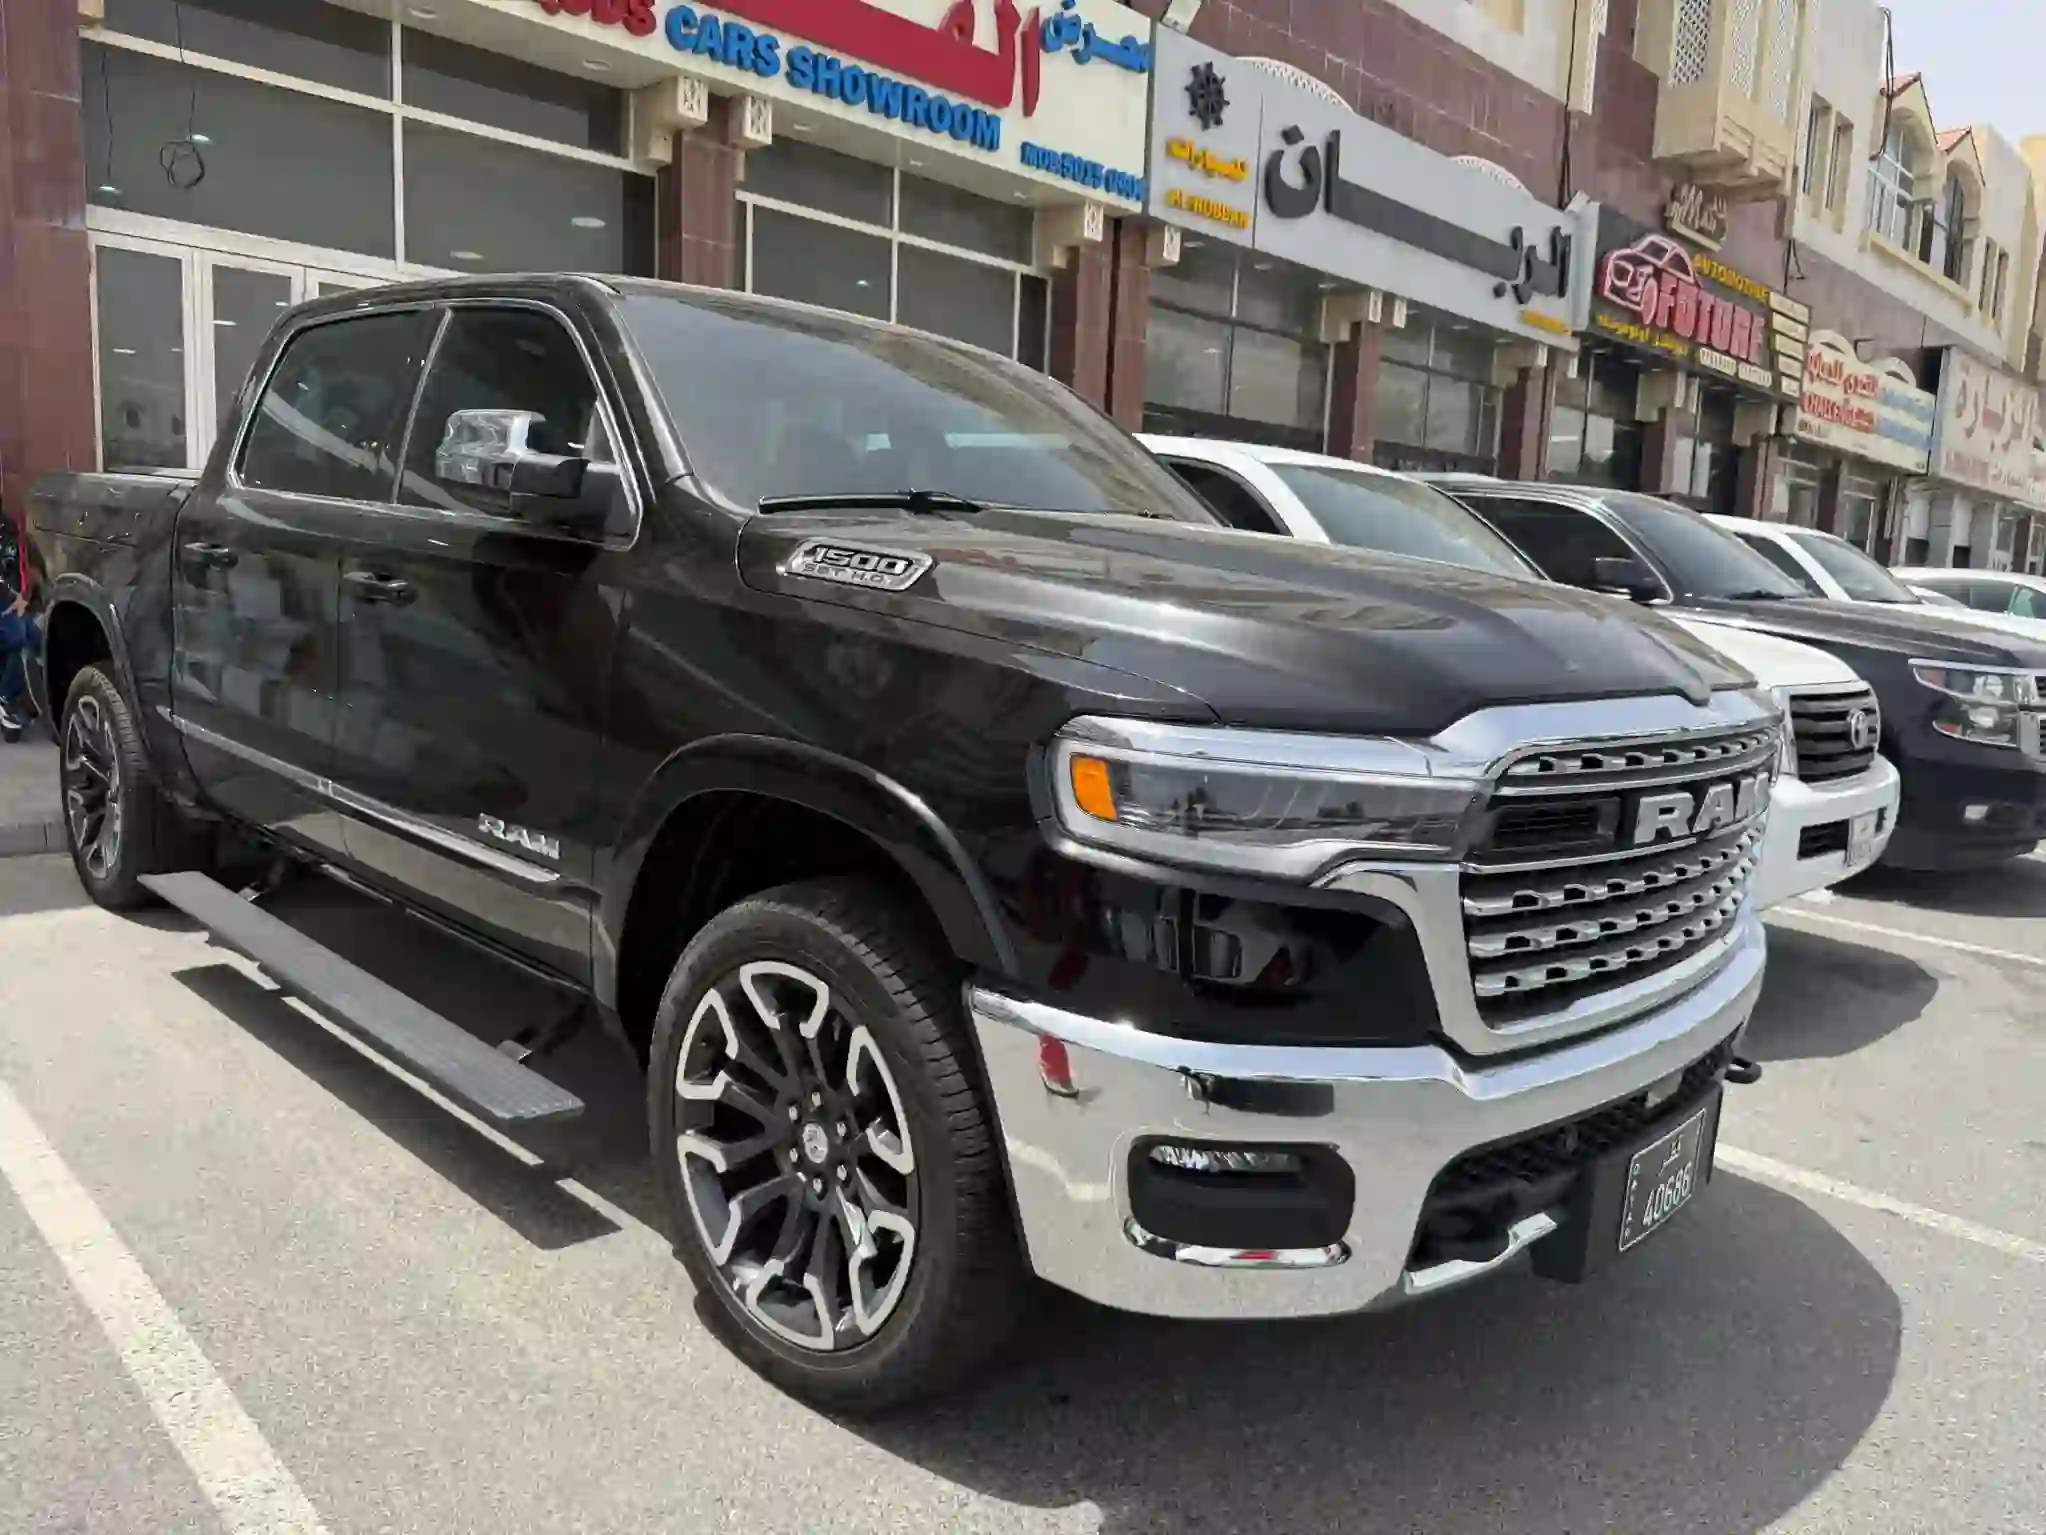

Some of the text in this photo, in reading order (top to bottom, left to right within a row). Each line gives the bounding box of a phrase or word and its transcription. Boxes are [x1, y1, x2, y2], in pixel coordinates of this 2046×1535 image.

[665, 5, 780, 77] CARS
[786, 46, 1001, 152] SHOWROOM
[813, 547, 908, 575] 1500
[1634, 772, 1769, 845] RAM
[1642, 1160, 1693, 1228] 40686
